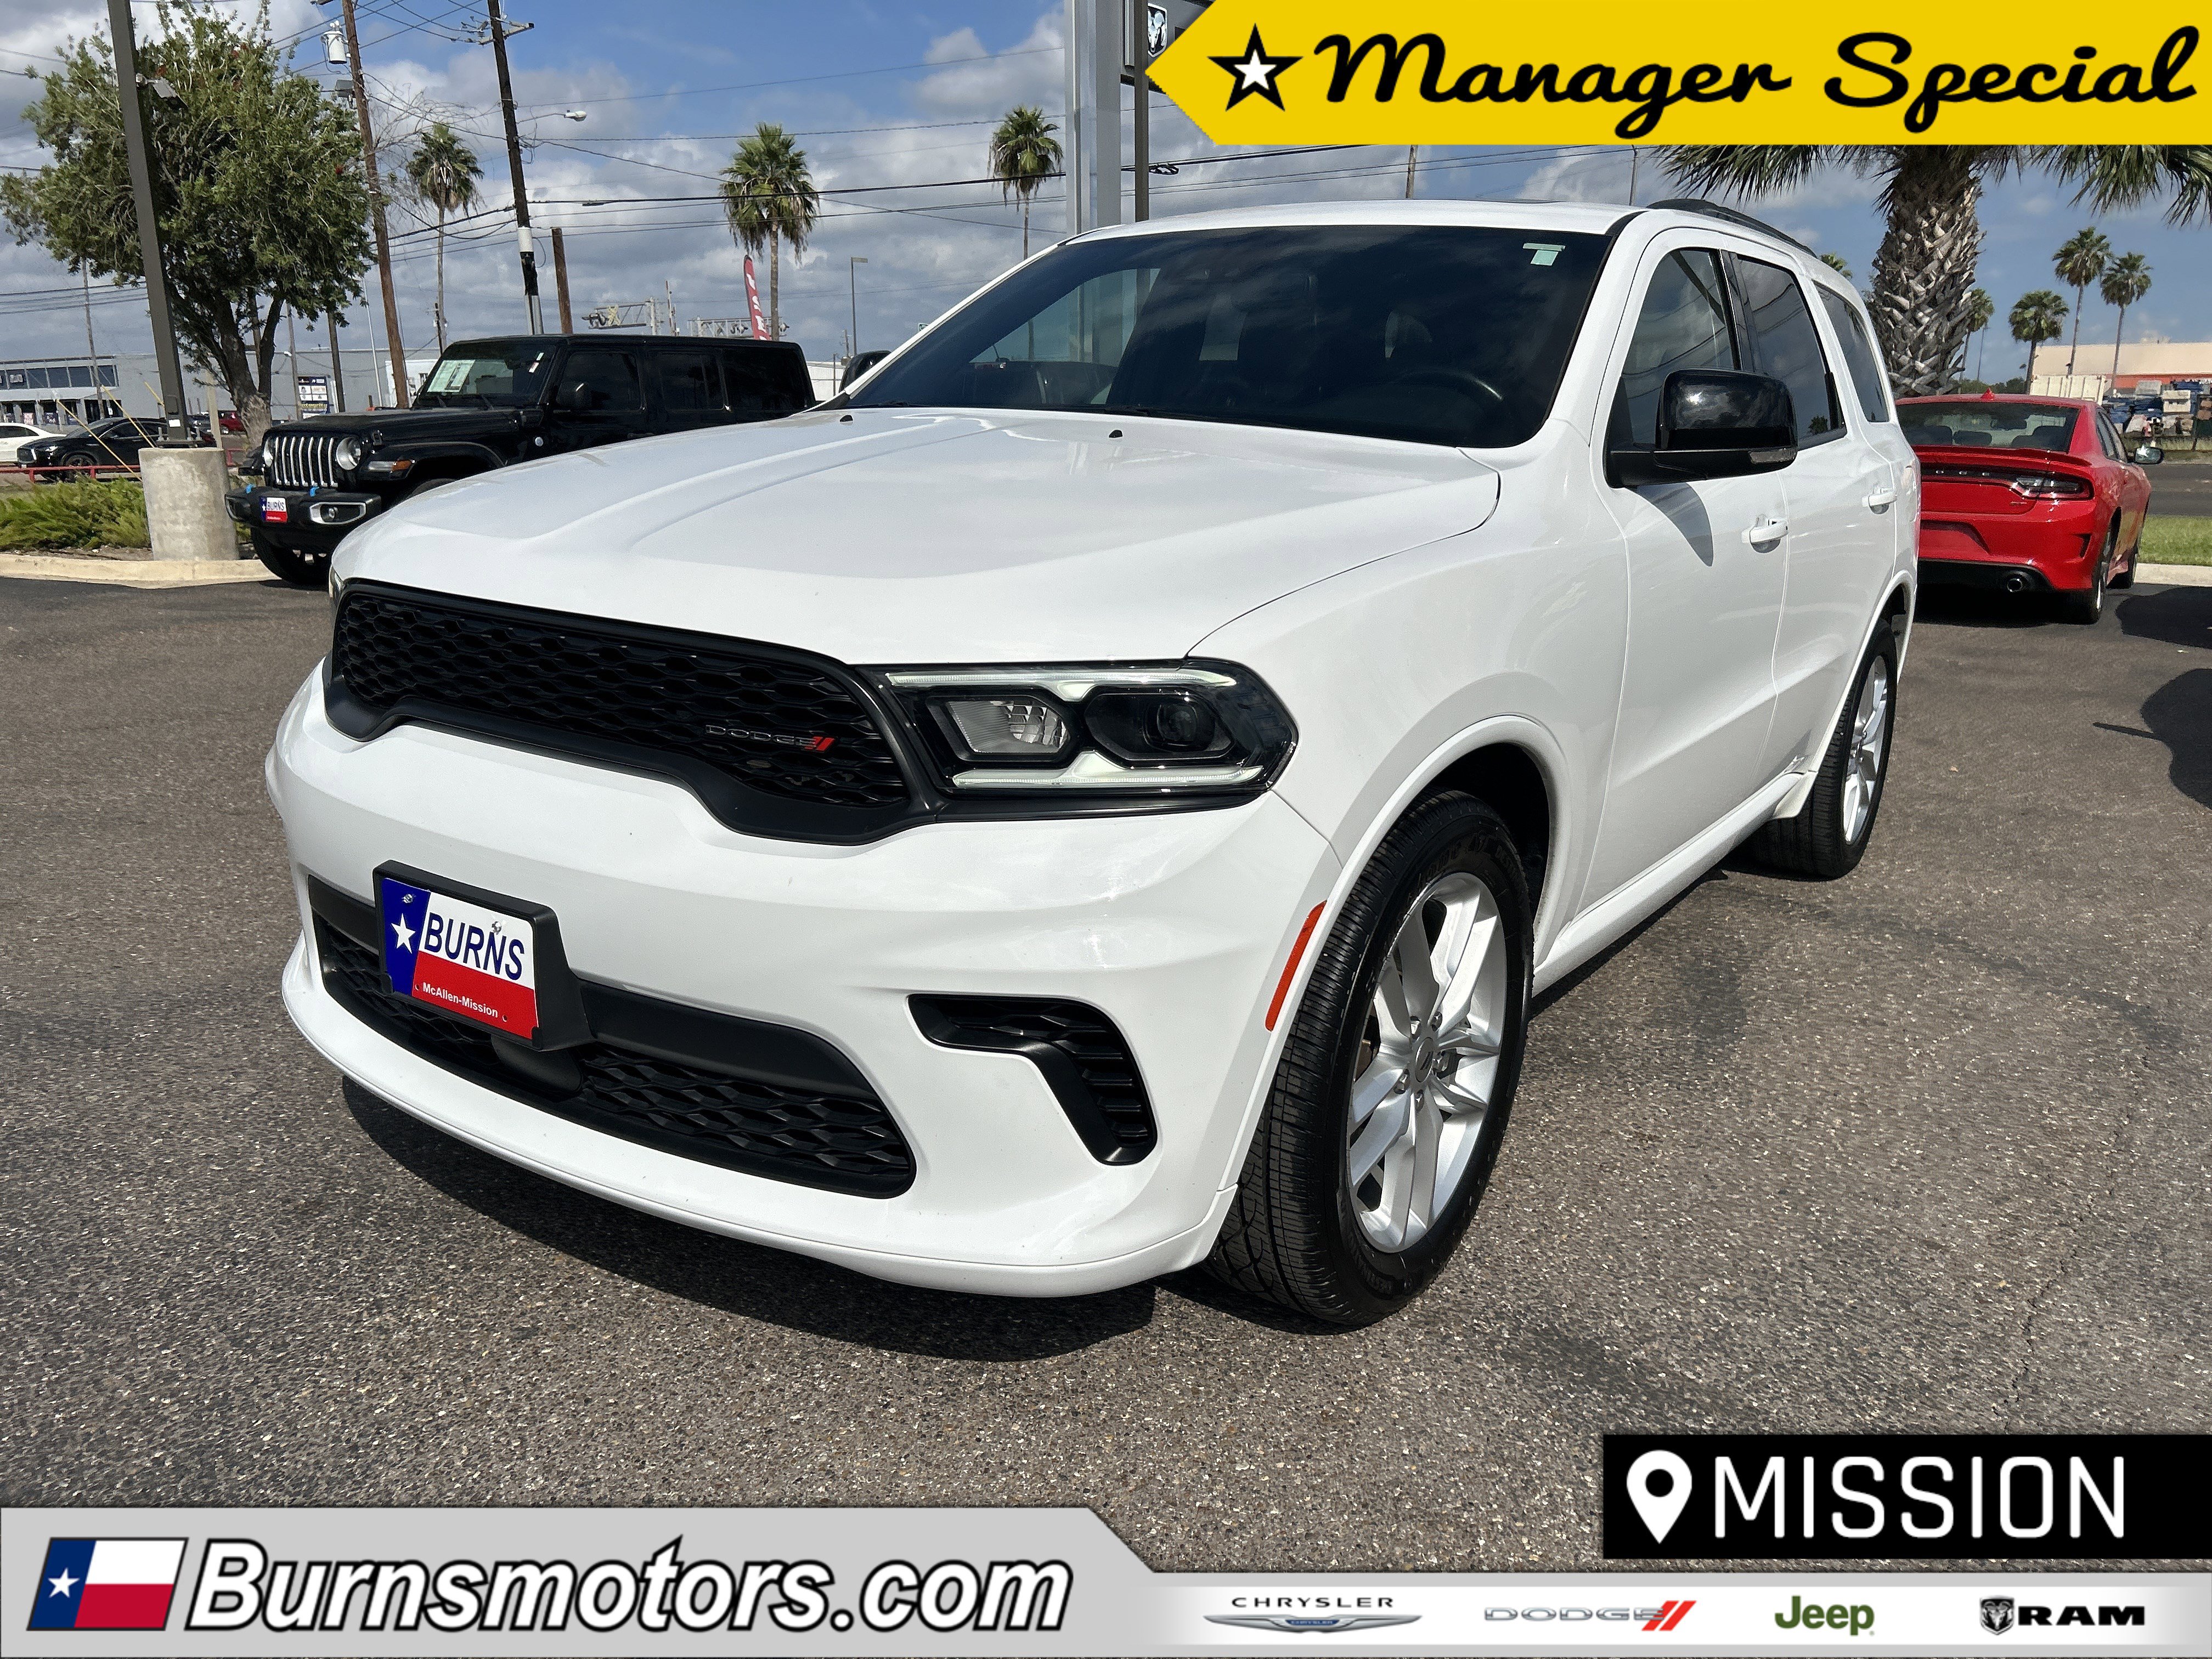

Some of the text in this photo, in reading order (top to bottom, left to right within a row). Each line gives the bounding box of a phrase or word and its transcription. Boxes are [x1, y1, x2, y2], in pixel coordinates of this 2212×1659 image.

[267, 501, 285, 511] BURNS
[706, 724, 817, 748] DODGE
[424, 912, 525, 981] BURNS
[422, 981, 499, 1018] McAllen-Mission
